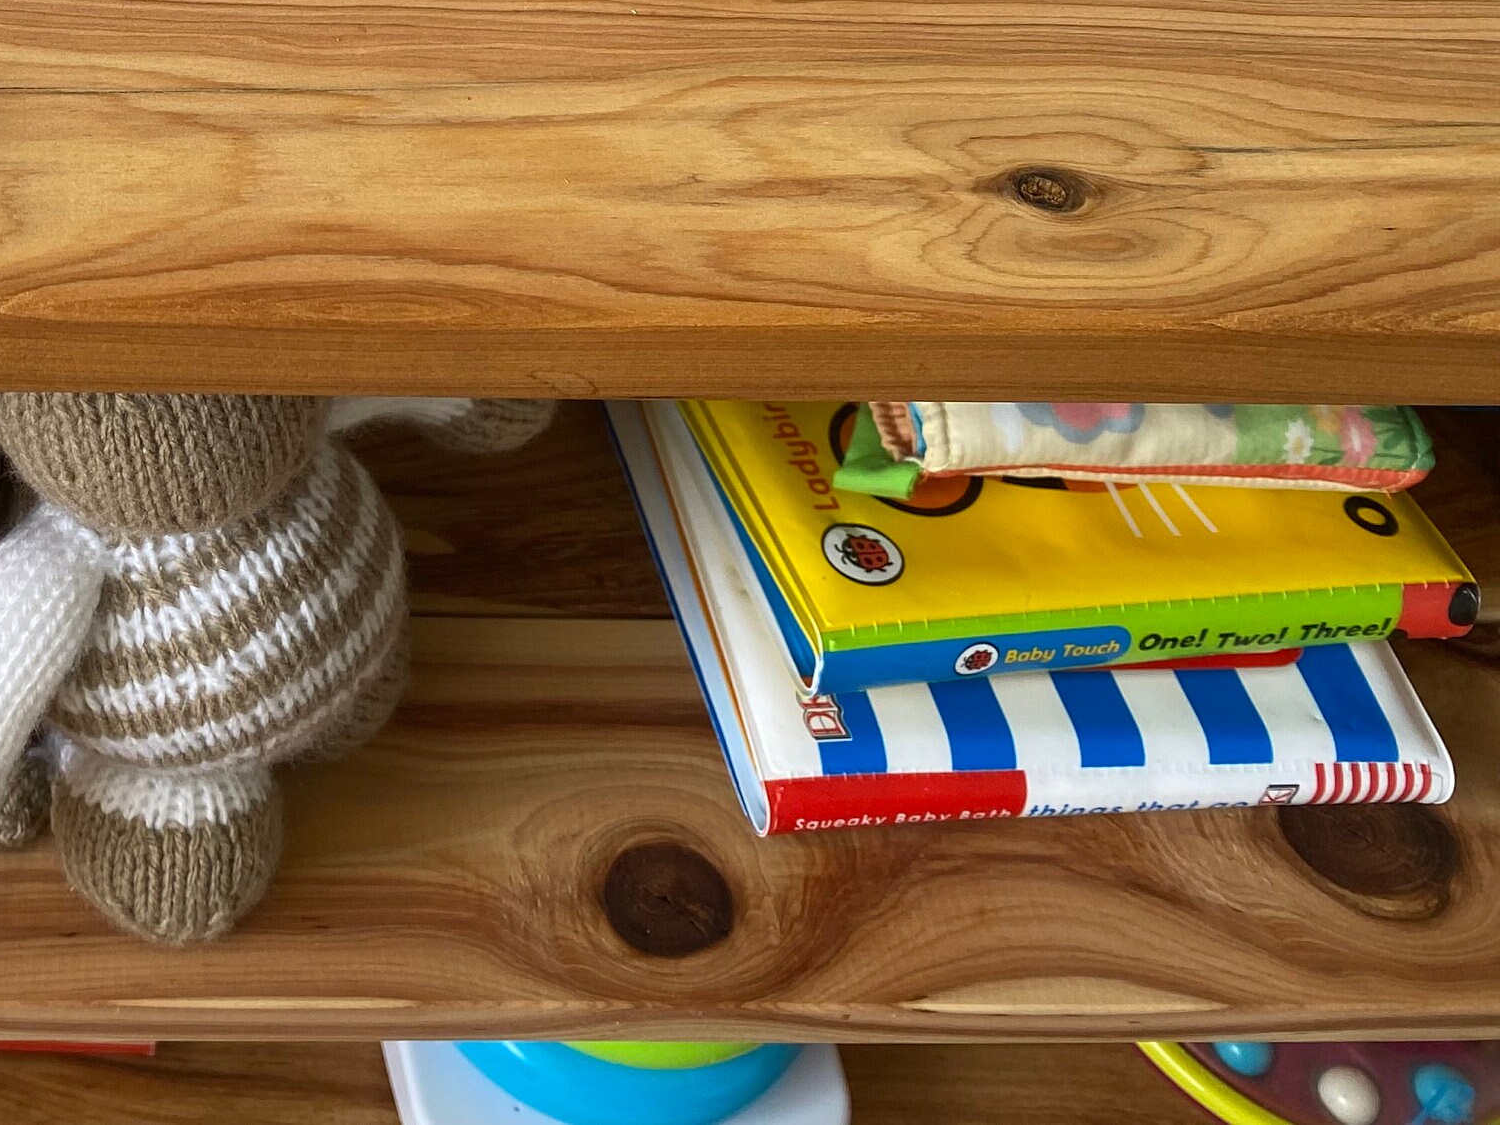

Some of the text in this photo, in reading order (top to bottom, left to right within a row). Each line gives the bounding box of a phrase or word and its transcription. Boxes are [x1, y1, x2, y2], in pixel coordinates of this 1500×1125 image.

[762, 401, 840, 511] Ladybir
[1137, 617, 1393, 650] One! Two! Three!
[1004, 639, 1120, 663] Baby Touch
[793, 814, 887, 831] Squeaky
[958, 808, 1012, 820] Bath
